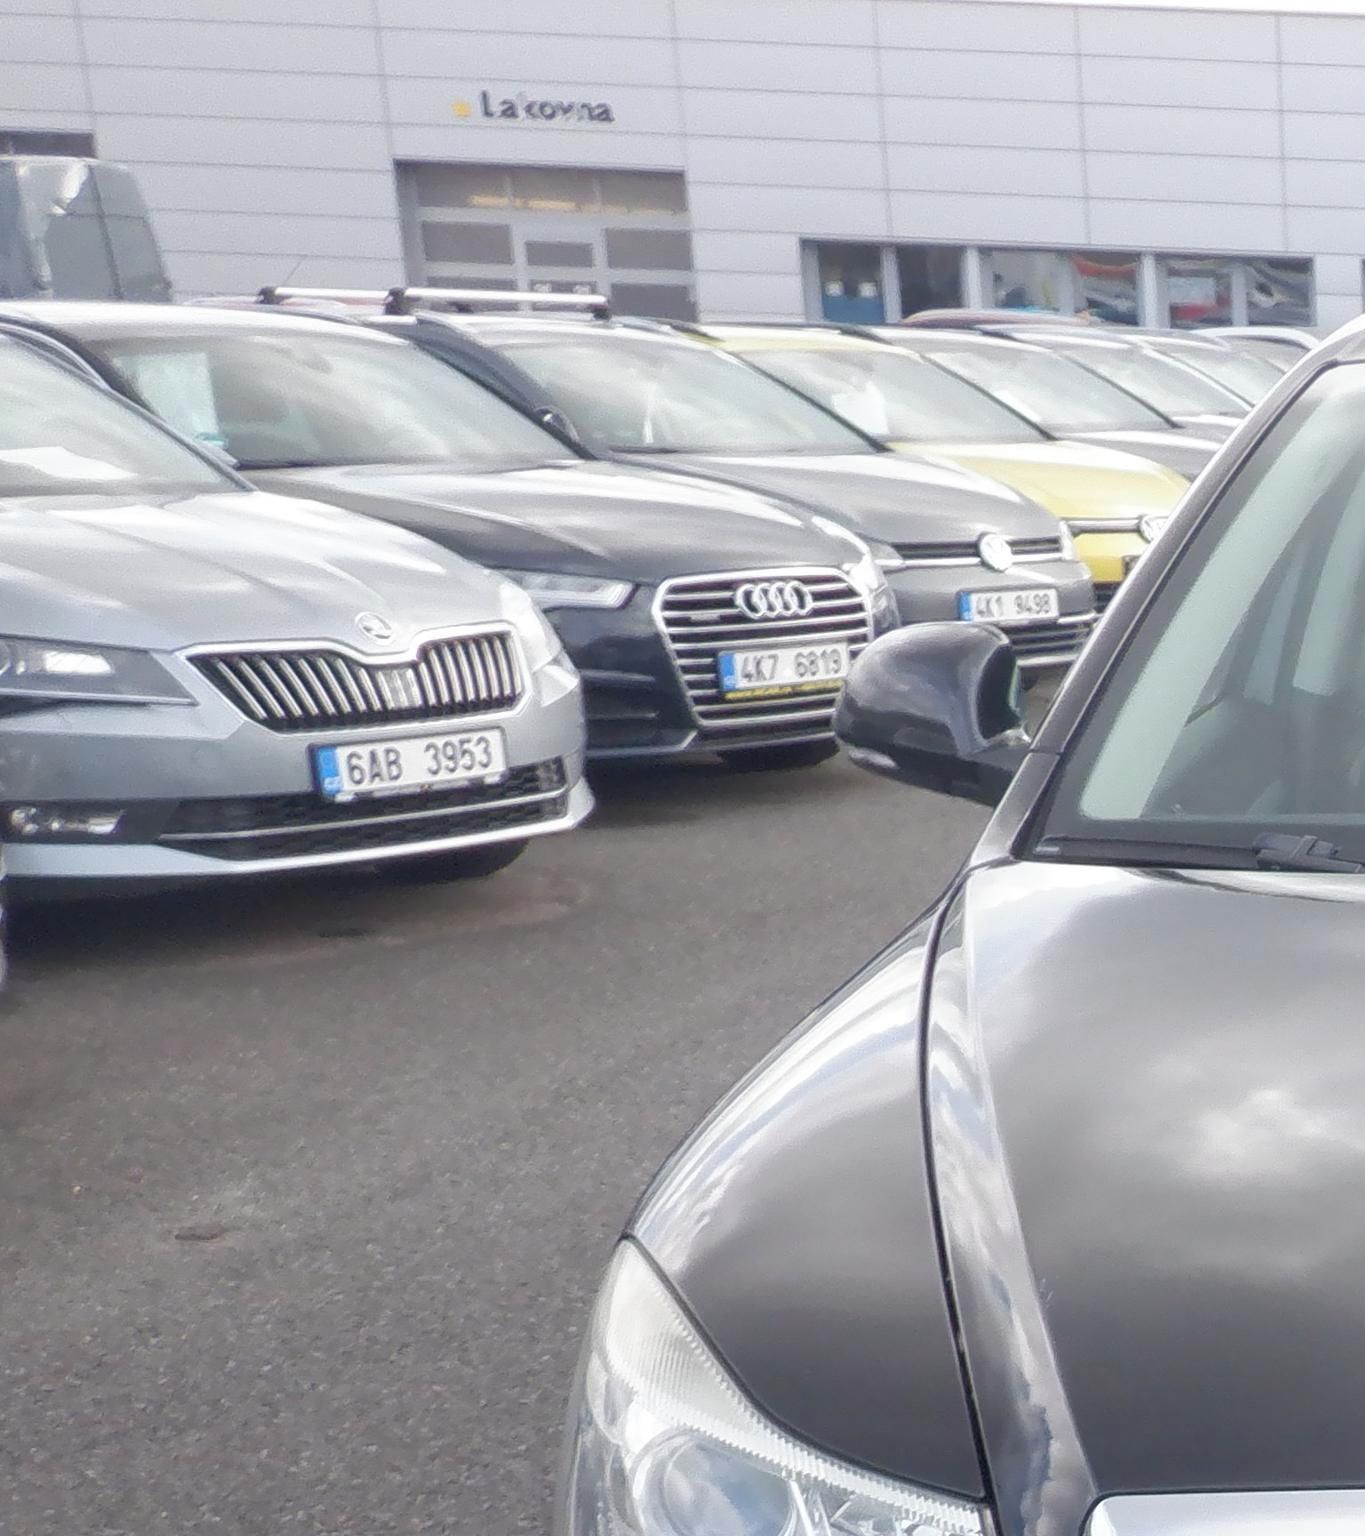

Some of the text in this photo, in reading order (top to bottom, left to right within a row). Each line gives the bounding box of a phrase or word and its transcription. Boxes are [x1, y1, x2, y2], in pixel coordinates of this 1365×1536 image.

[741, 649, 842, 682] 4K7 6819
[347, 736, 492, 785] 6AB 3953
